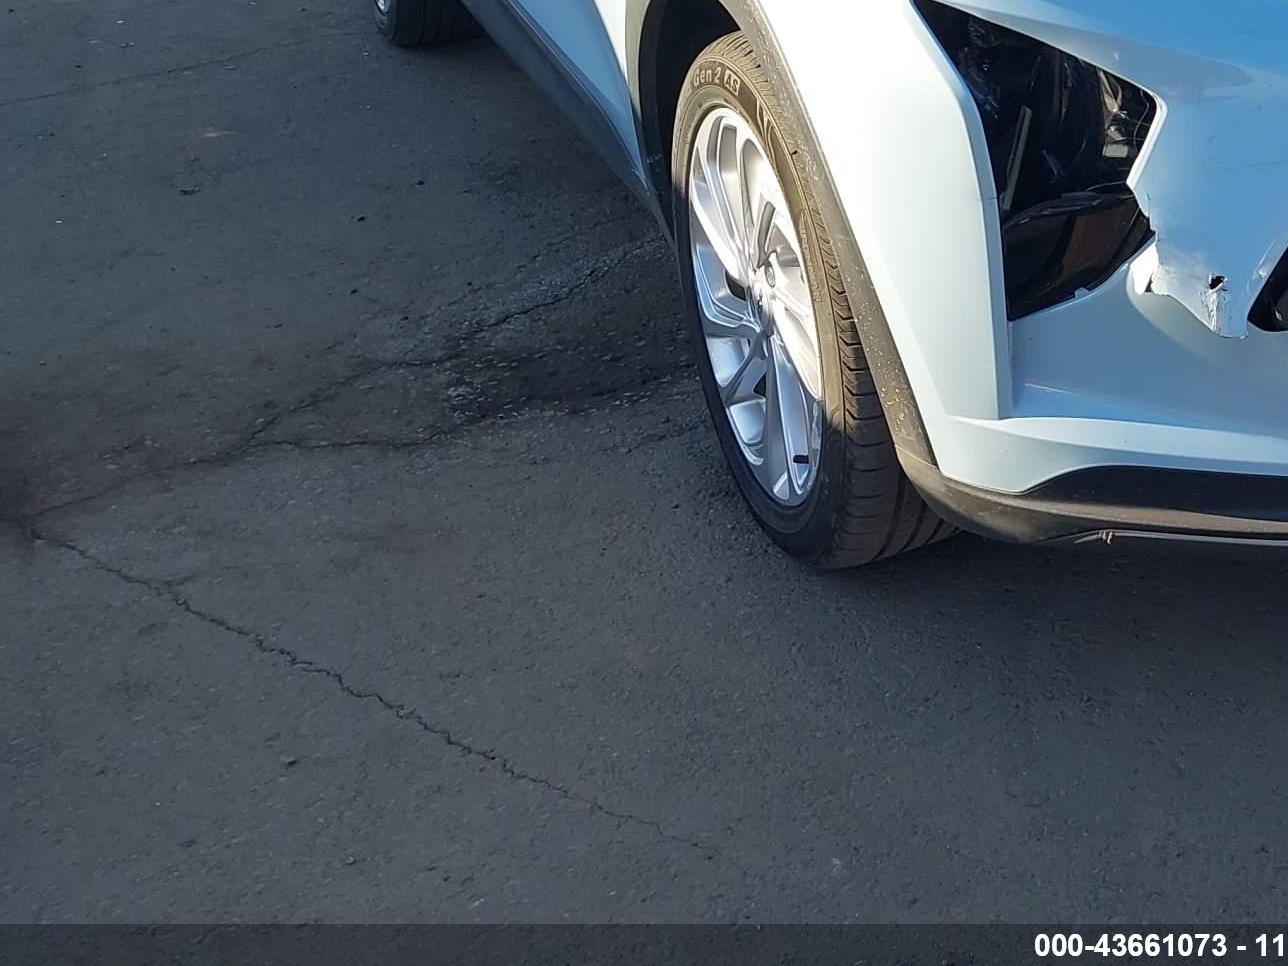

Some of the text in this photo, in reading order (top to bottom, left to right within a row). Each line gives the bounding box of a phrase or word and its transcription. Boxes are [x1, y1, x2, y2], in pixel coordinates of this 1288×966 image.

[693, 67, 739, 93] Gen 2 AS
